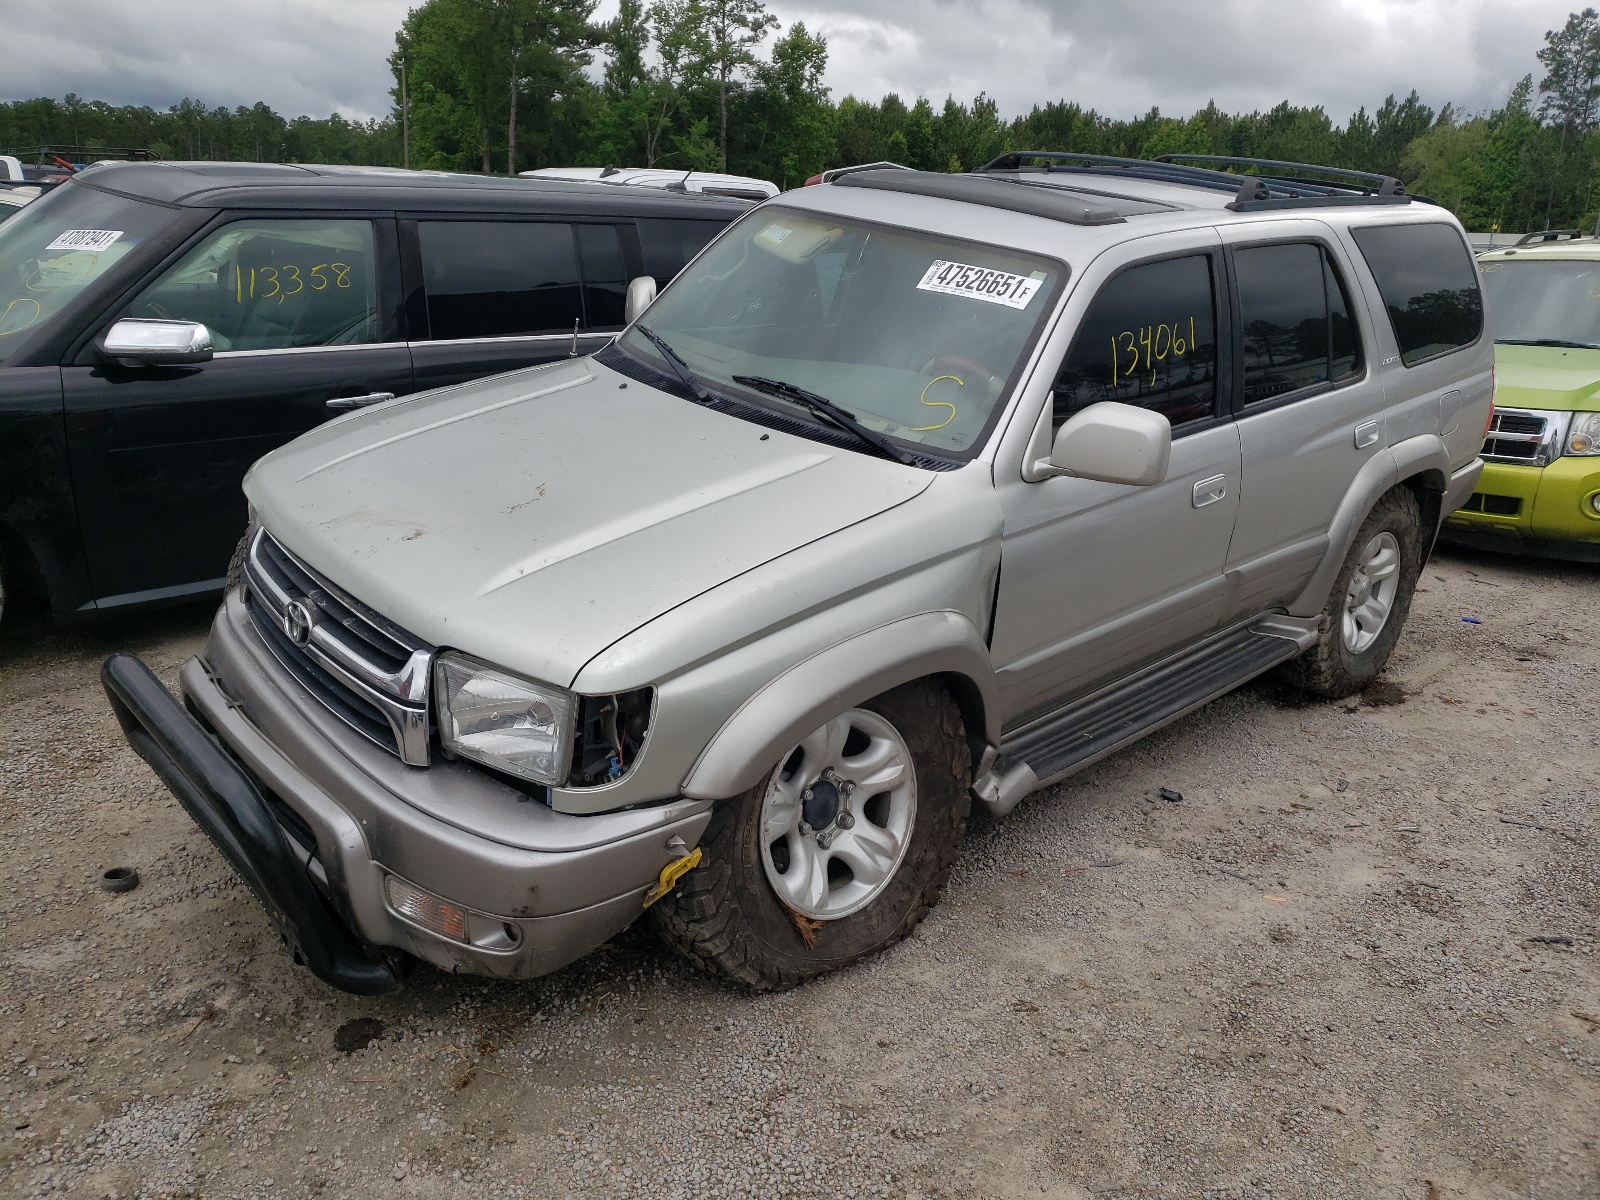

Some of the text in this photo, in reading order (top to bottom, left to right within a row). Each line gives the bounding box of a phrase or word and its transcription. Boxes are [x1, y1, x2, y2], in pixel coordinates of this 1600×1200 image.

[236, 262, 351, 305] 113,358
[937, 263, 1025, 299] 47526651
[1111, 316, 1195, 388] 134,061
